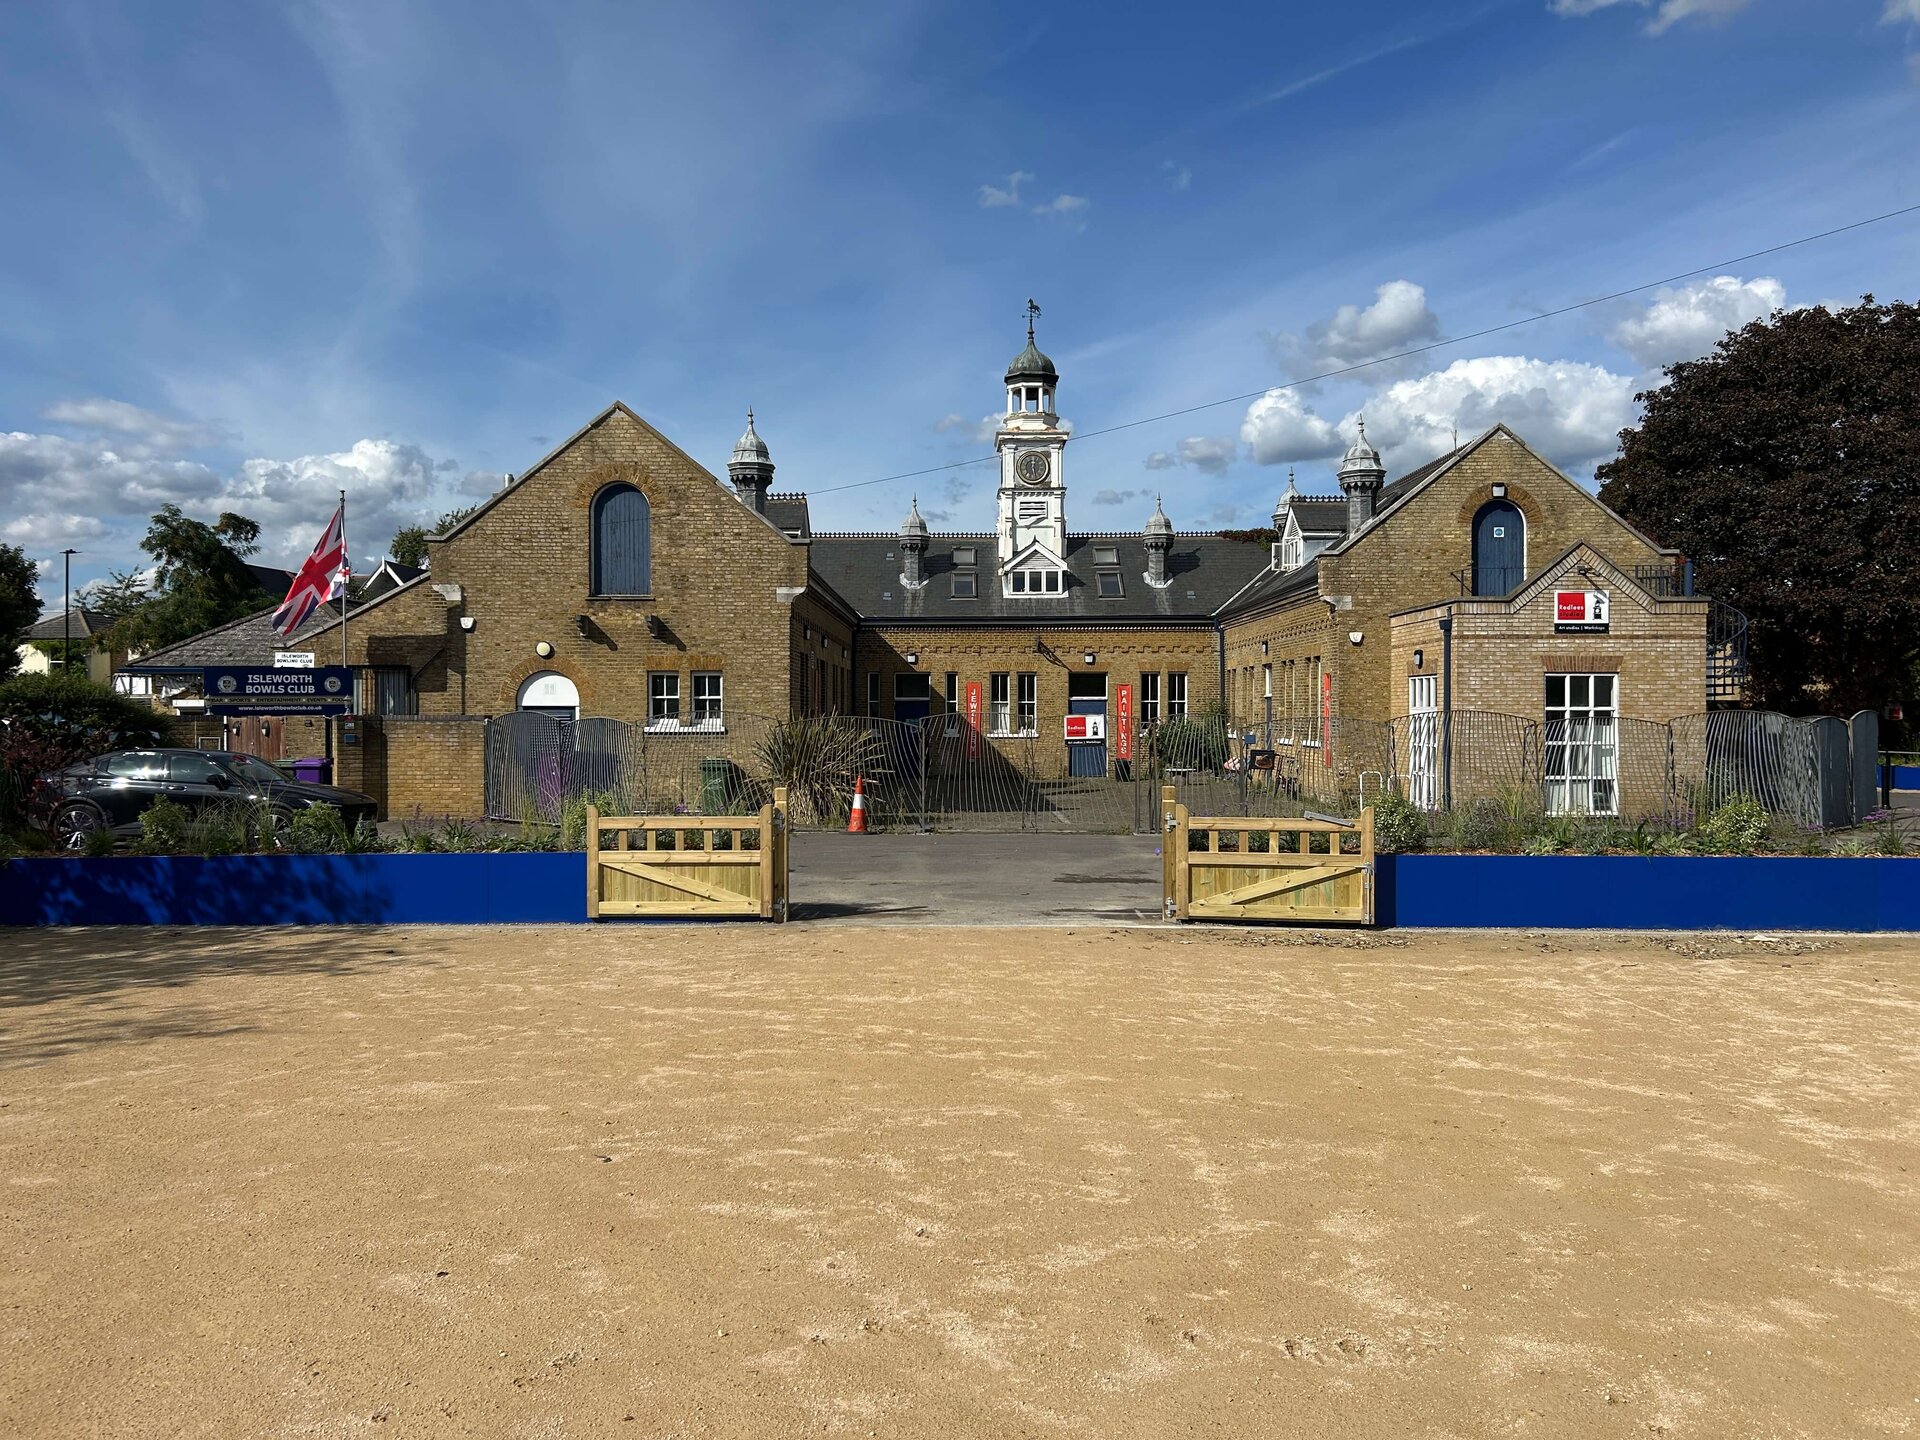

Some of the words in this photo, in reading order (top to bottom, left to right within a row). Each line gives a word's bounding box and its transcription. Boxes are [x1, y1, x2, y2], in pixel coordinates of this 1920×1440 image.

[247, 674, 313, 683] ISLEWORTH
[245, 685, 285, 694] BOWLS
[287, 685, 316, 694] CLUB
